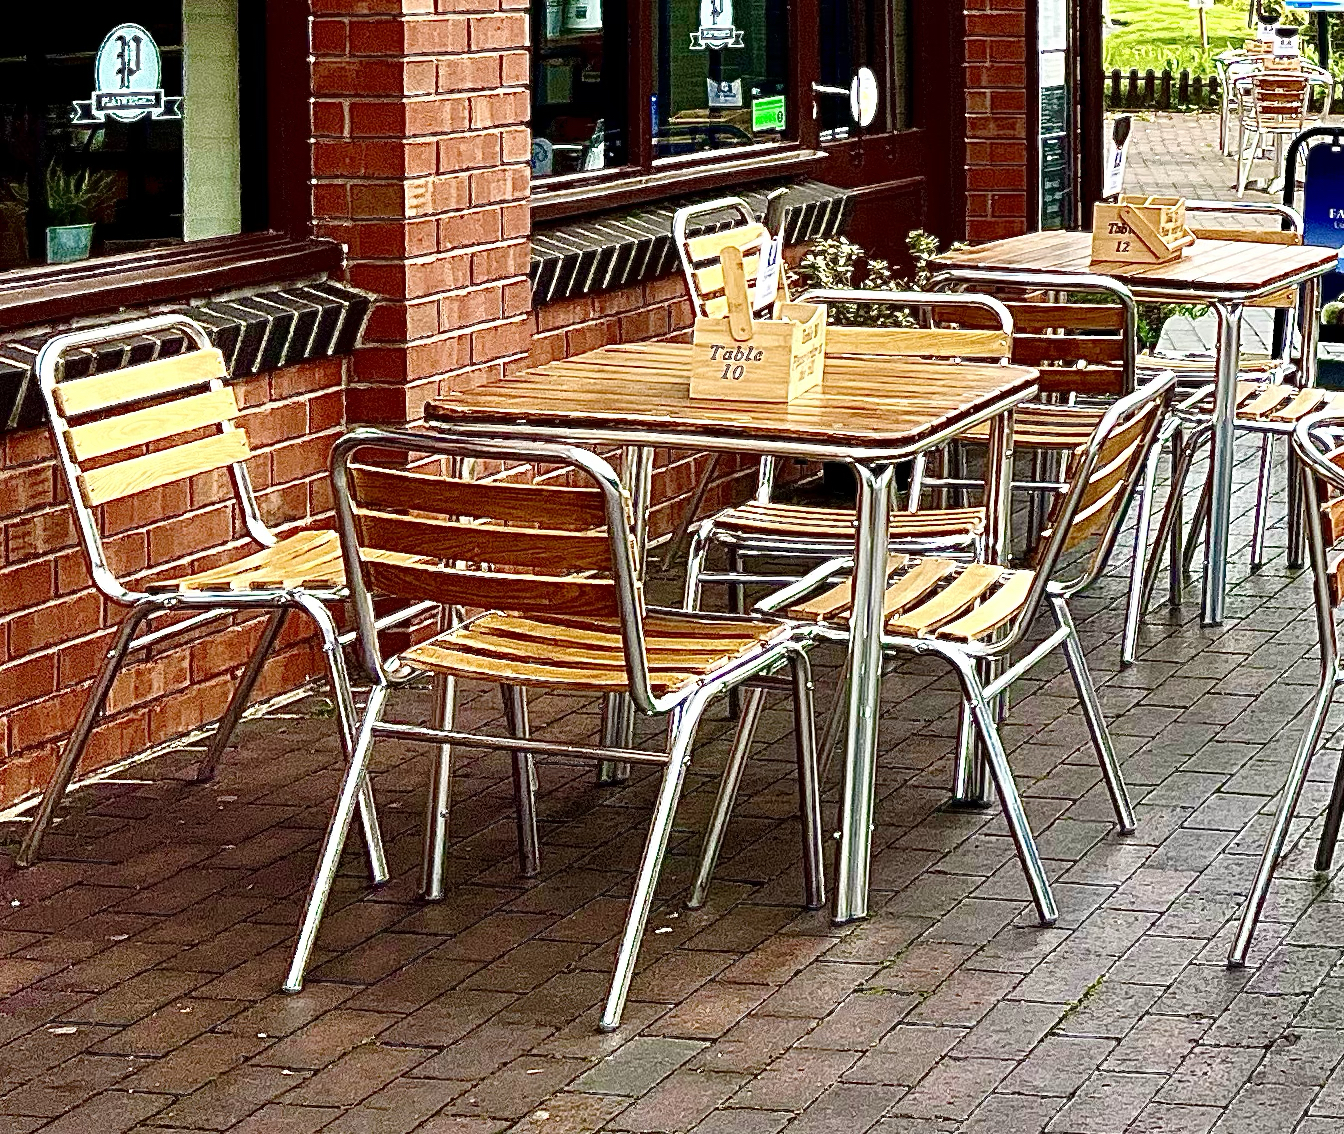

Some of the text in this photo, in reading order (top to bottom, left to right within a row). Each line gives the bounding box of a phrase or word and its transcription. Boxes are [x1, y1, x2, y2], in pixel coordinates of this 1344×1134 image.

[1107, 222, 1134, 236] Tabl
[1115, 240, 1131, 253] 12
[710, 344, 764, 363] Table
[720, 363, 745, 381] 10
